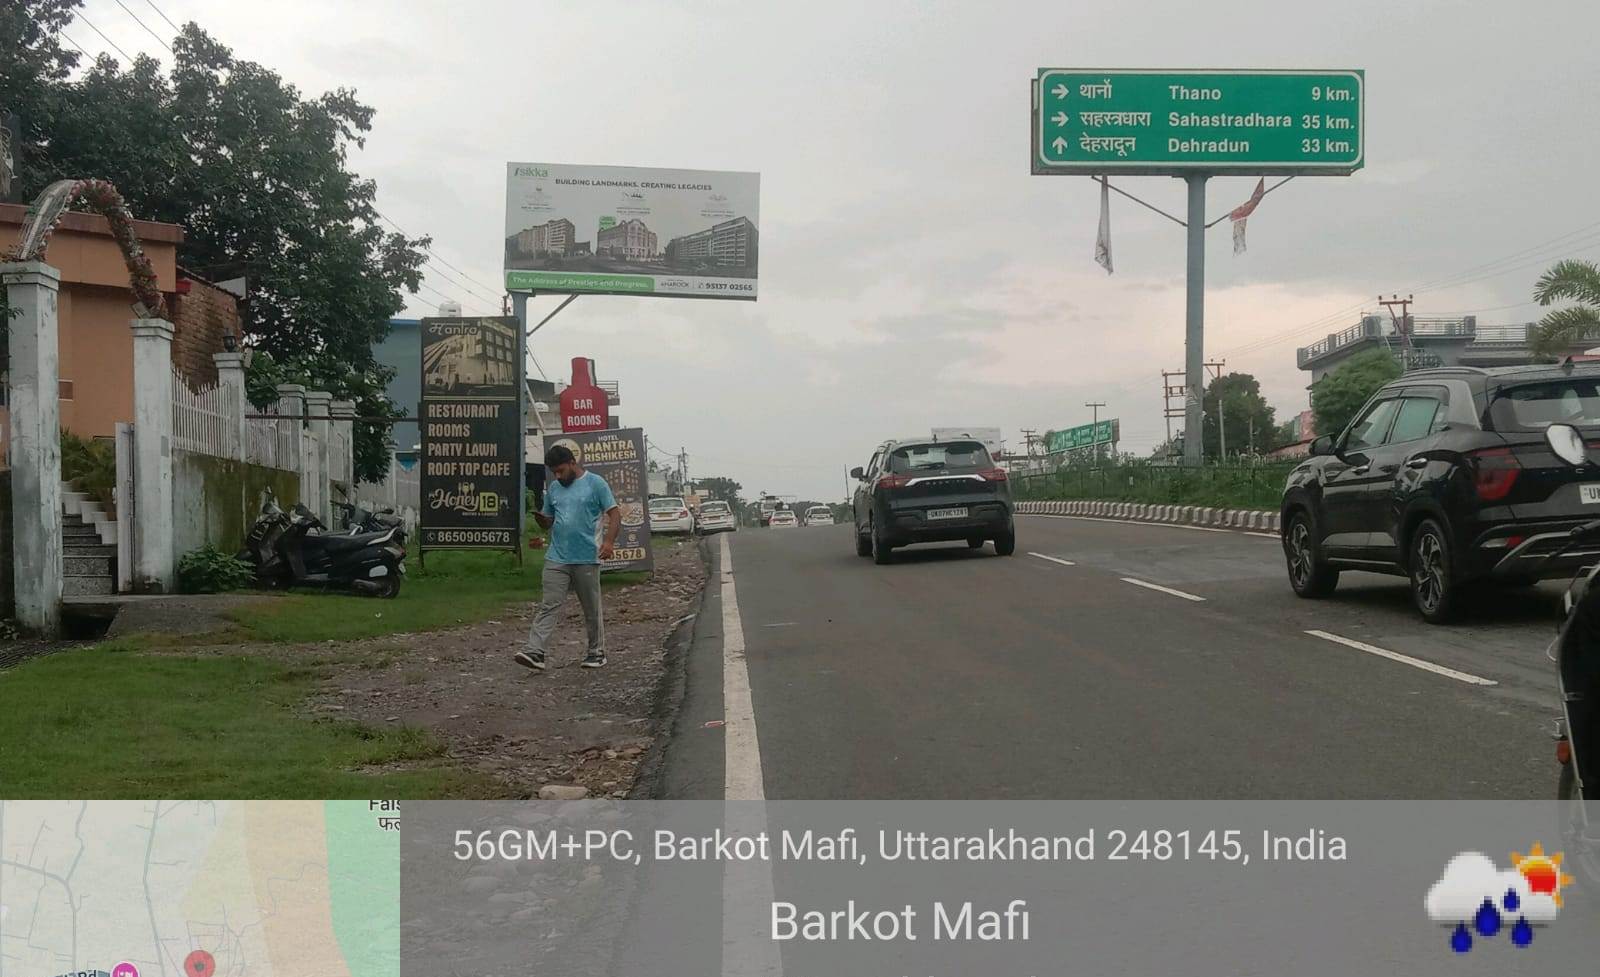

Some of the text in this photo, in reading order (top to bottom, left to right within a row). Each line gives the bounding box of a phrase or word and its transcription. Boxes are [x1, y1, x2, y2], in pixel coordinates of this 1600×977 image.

[1079, 79, 1112, 99] थानों
[1168, 85, 1221, 101] Thano
[1311, 86, 1355, 101] 9 km.
[1168, 112, 1292, 128] Sahastradhara
[1302, 114, 1355, 129] 35 km.
[1079, 135, 1136, 156] देहरादून
[1168, 138, 1250, 153] Dehradun
[1302, 138, 1355, 153] 33 km.
[555, 178, 590, 187] BUILDING
[640, 181, 676, 190] CREATING
[678, 183, 712, 191] LEGACIES
[428, 404, 500, 419] RESTAURANT
[573, 399, 593, 410] BAR
[567, 414, 602, 427] ROOMS
[428, 423, 471, 438] ROOMS
[598, 434, 619, 442] HOTEL
[428, 443, 498, 457] PARTY LAWN
[583, 439, 635, 453] MANTRA
[584, 450, 637, 463] RISHIKESH
[427, 462, 510, 476] ROOF TOP CAFE
[430, 488, 480, 512] Honey
[482, 495, 496, 508] 18
[438, 531, 510, 543] 8650905678
